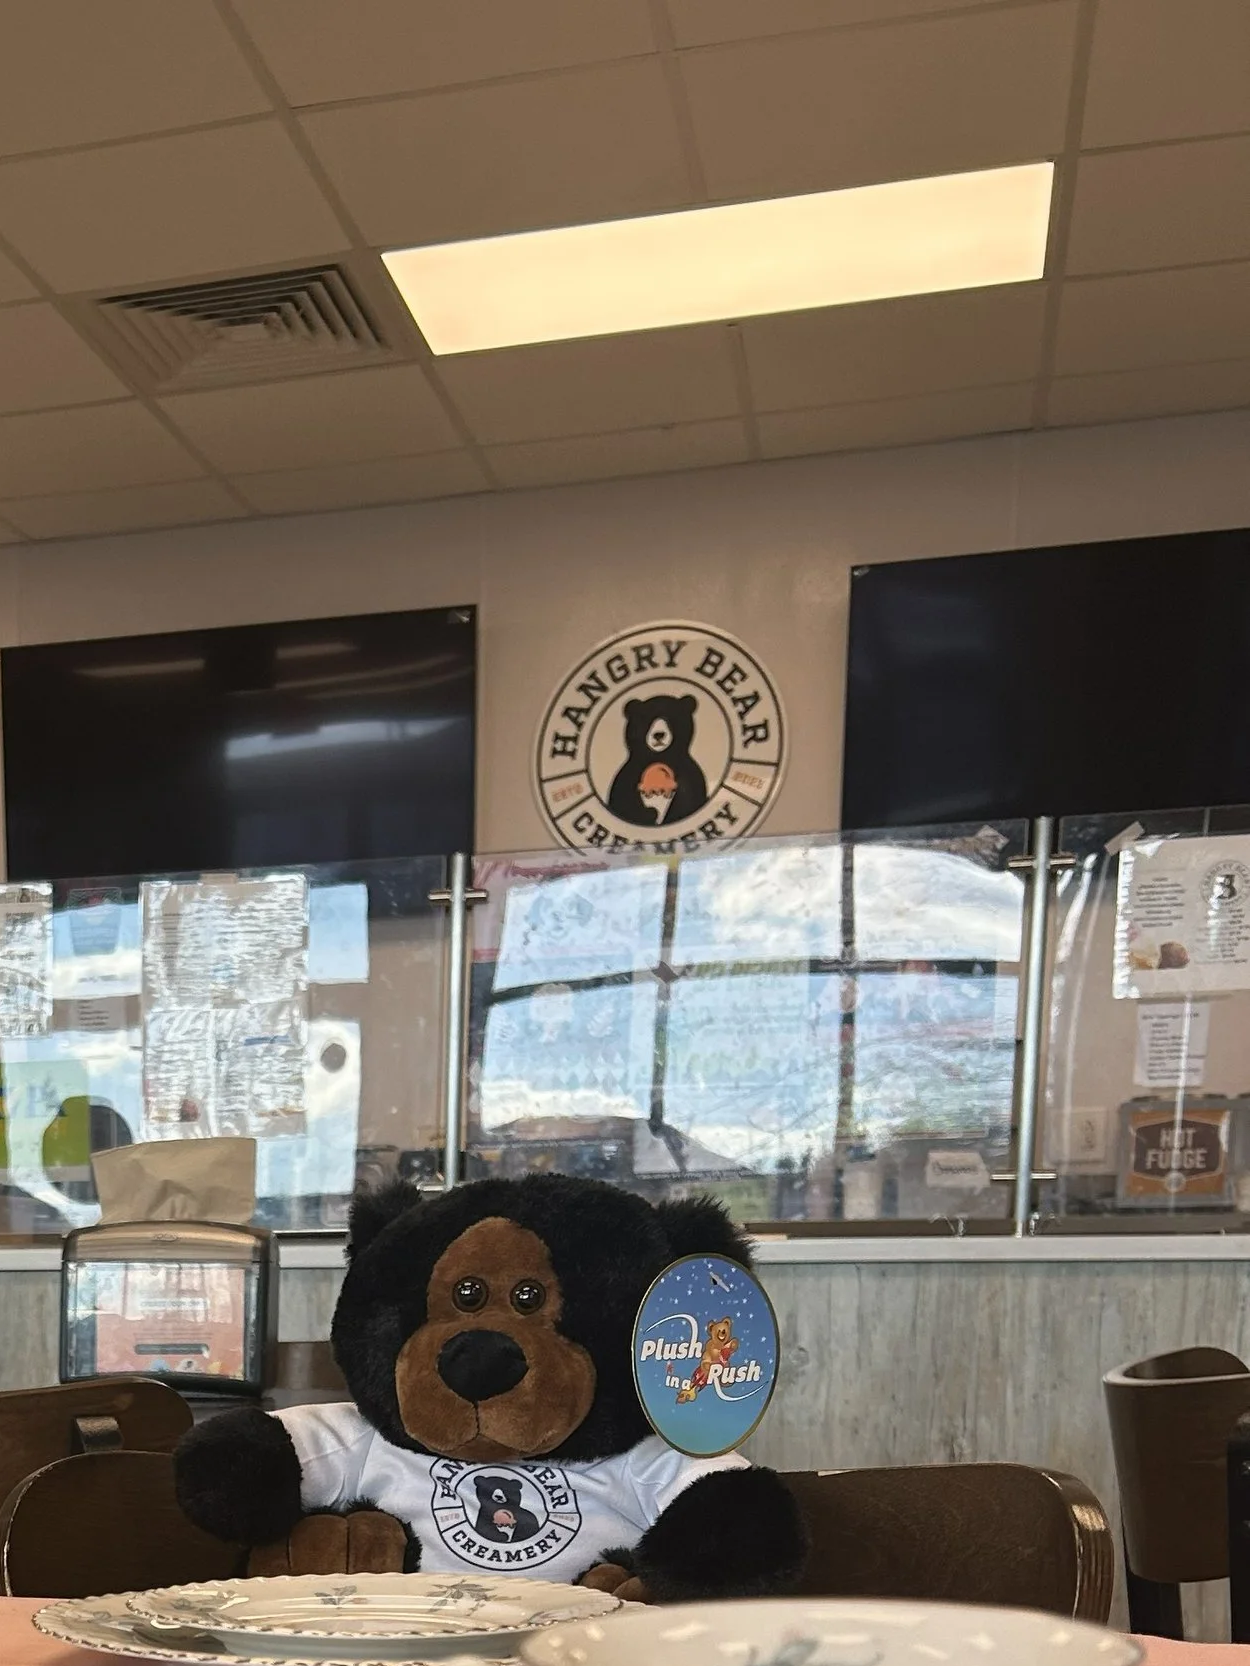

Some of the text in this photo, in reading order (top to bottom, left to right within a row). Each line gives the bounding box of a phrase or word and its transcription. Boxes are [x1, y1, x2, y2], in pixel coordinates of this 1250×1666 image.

[551, 639, 770, 760] HANGRY BEAR
[640, 1333, 703, 1362] Plush
[666, 1373, 692, 1390] in a
[707, 1361, 762, 1388] Rush
[452, 1528, 562, 1563] CREAMERY
